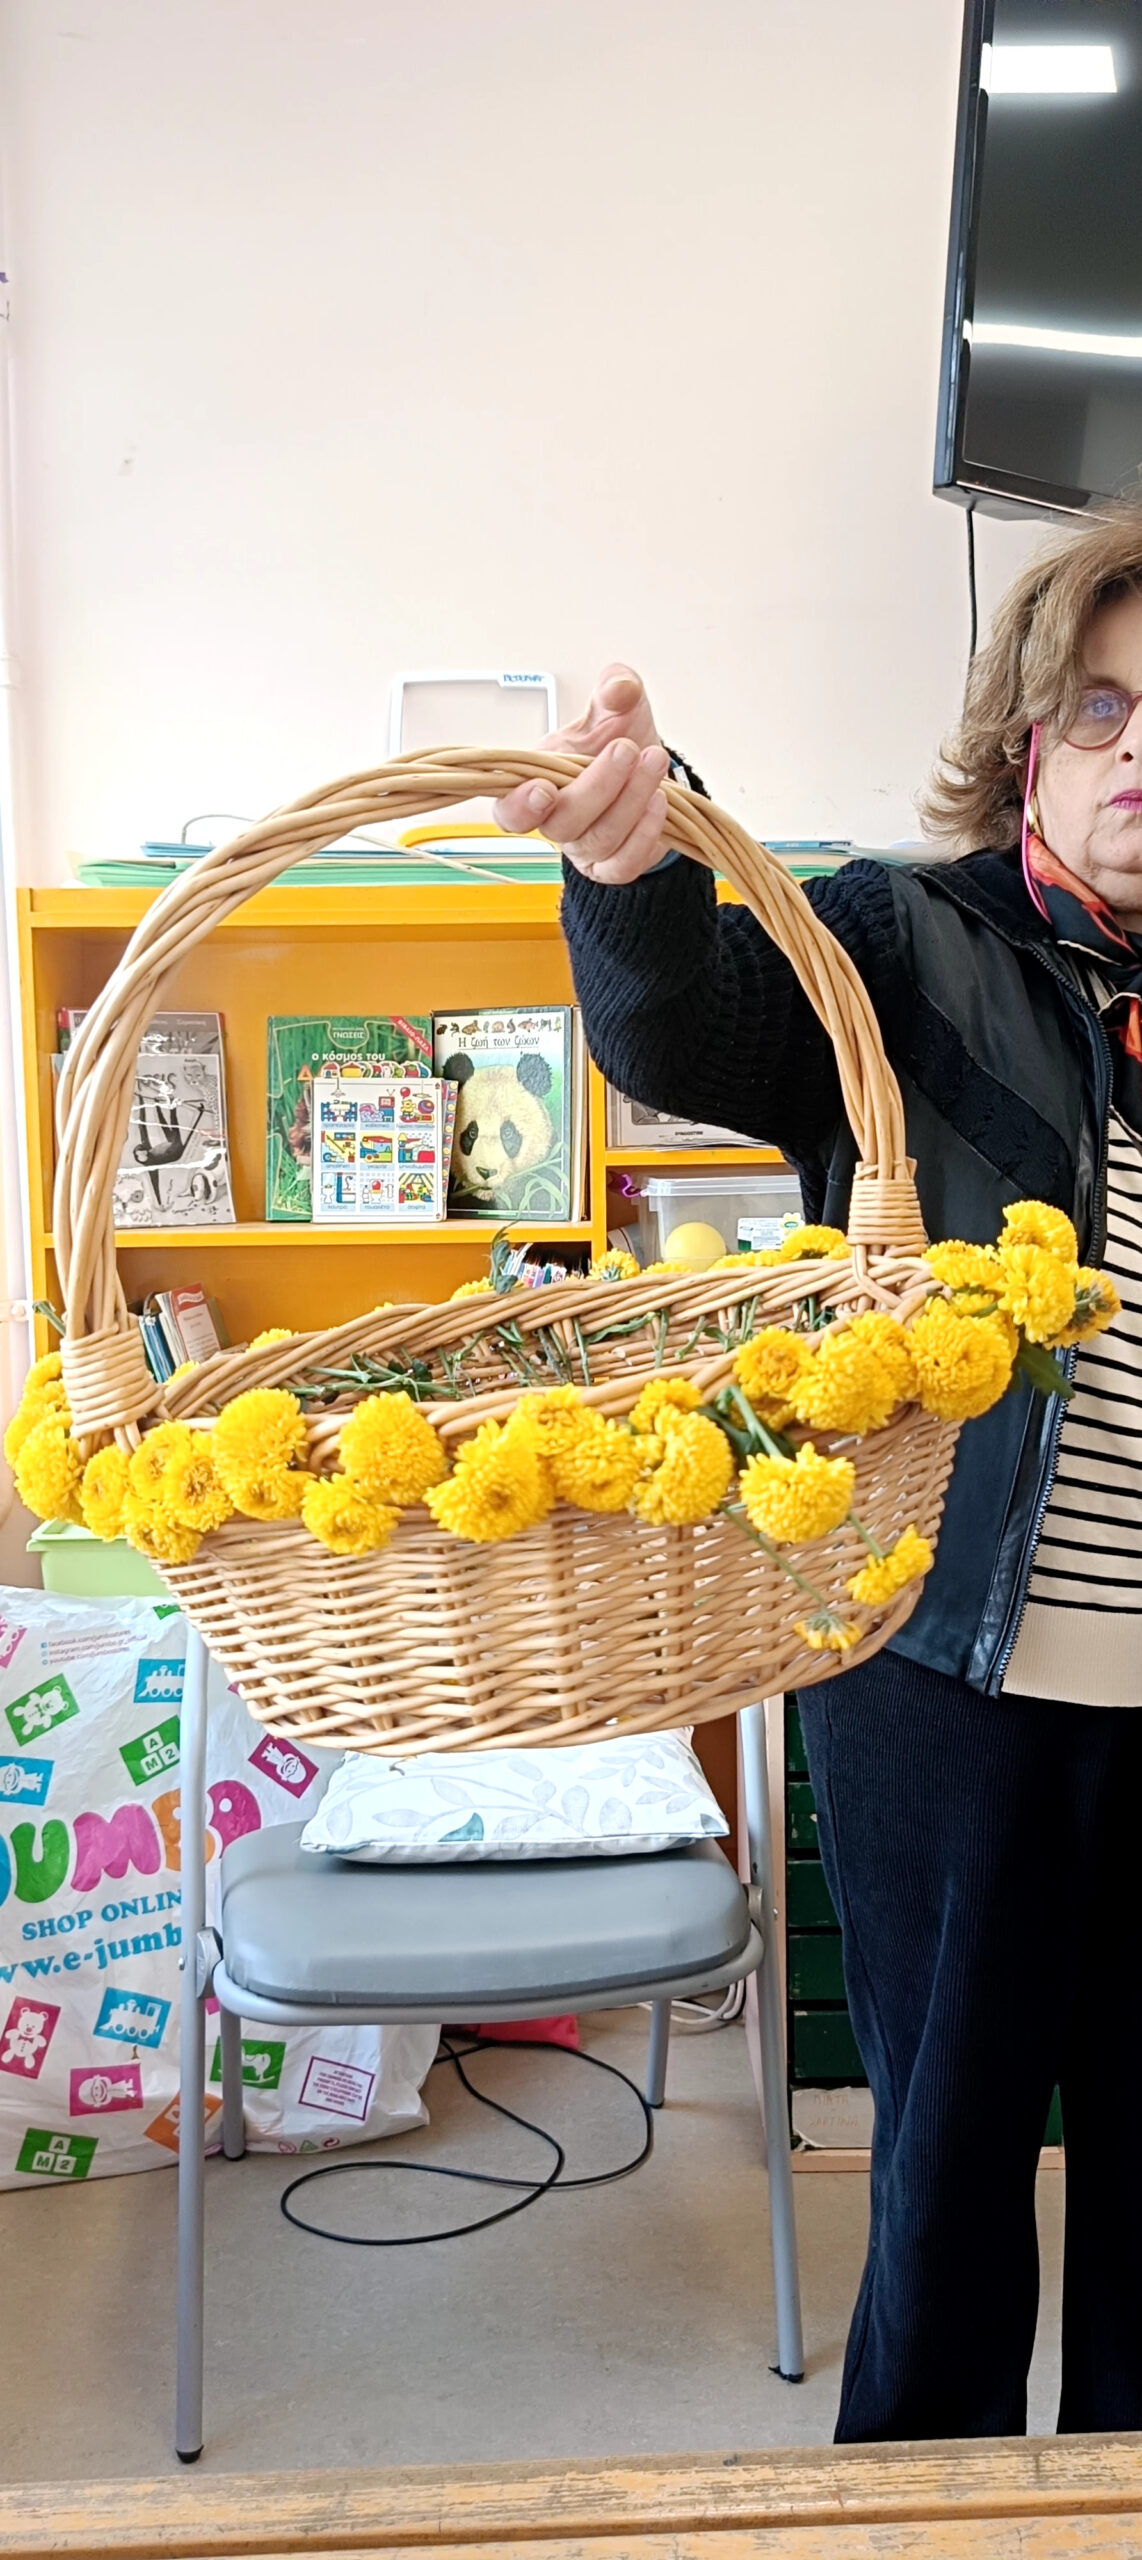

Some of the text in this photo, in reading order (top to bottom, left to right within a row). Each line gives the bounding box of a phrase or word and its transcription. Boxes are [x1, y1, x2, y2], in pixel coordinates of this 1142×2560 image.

[458, 1037, 467, 1048] Η
[471, 1036, 489, 1049] ζωή
[493, 1038, 511, 1047] των
[322, 1050, 363, 1062] κόσμος
[366, 1053, 386, 1061] του
[149, 1738, 159, 1749] A
[145, 1748, 175, 1771] M 2
[0, 1780, 261, 1907] UMBO
[22, 1889, 181, 1940] SHOP ONLIN
[54, 2140, 64, 2150] A
[36, 2155, 70, 2170] M 2
